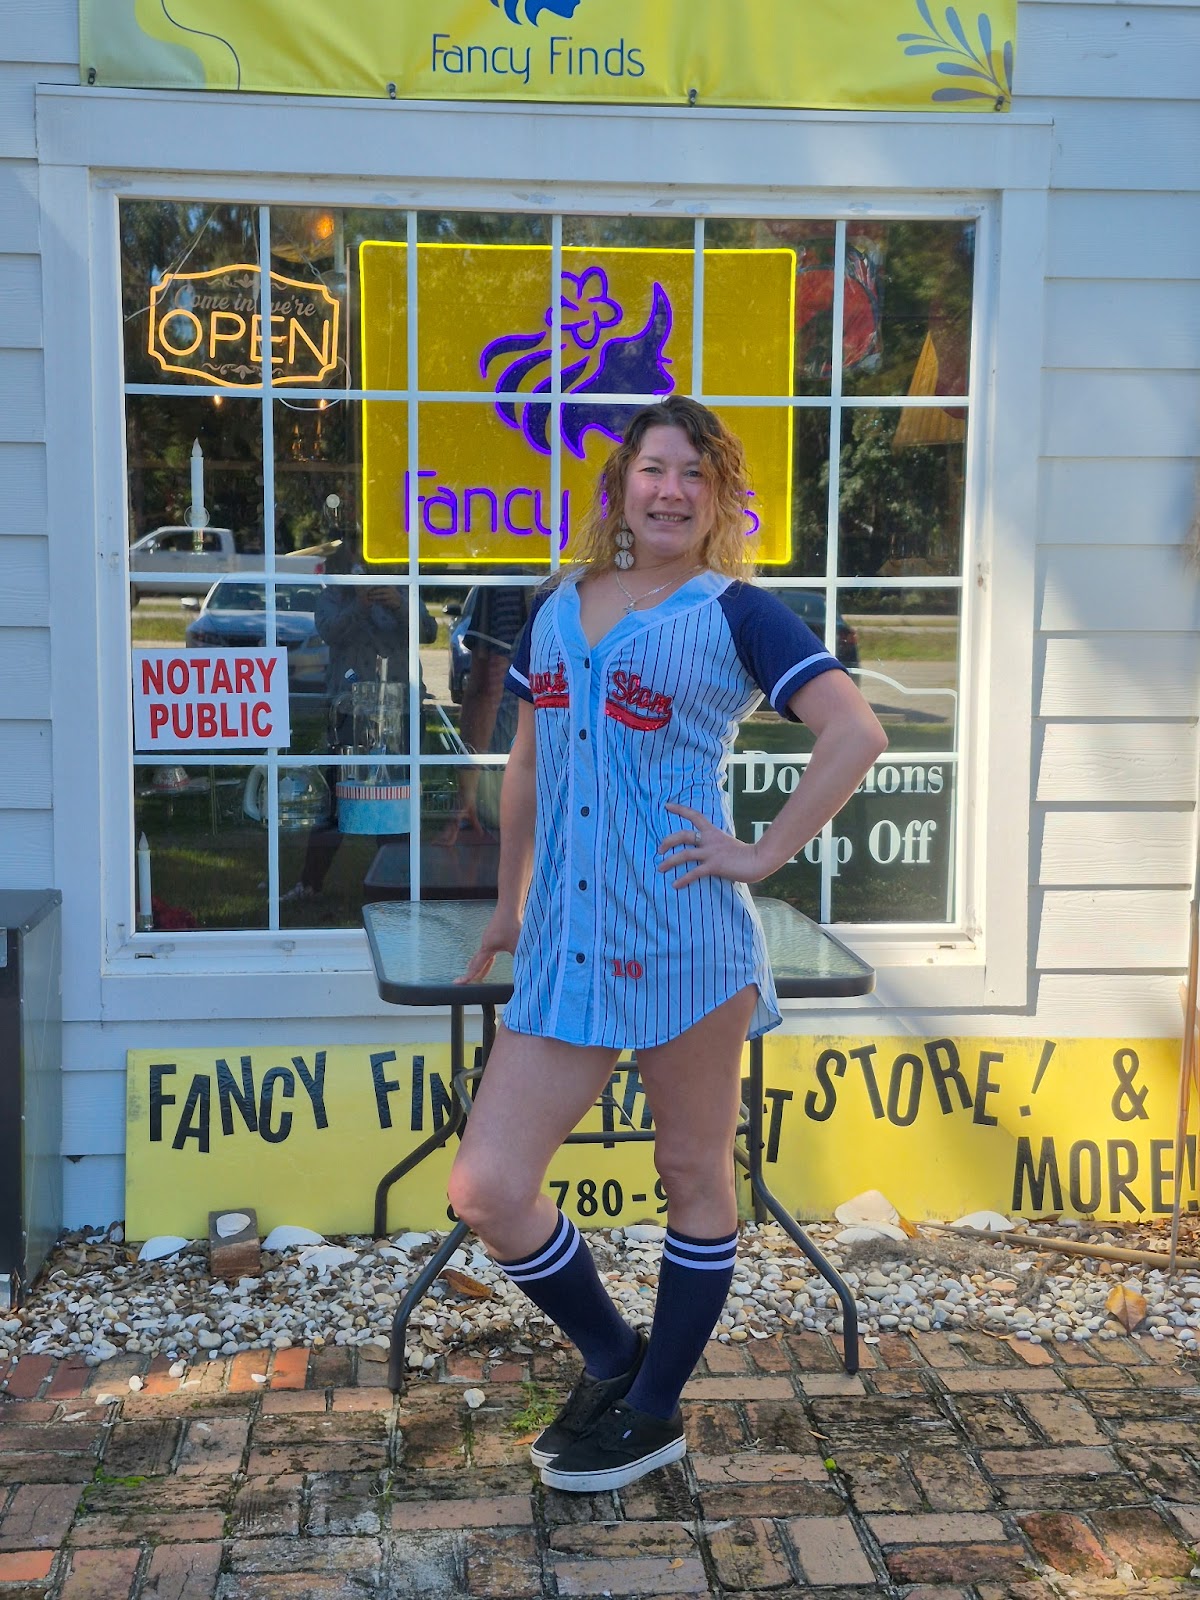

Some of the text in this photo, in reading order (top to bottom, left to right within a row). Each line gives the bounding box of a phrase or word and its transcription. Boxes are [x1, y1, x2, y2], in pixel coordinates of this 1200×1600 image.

[432, 33, 646, 85] Fancy Finds
[174, 284, 230, 312] Come
[158, 308, 330, 367] OPEN
[404, 470, 571, 551] Fancy
[141, 657, 278, 695] NOTARY
[611, 669, 674, 716] Slam
[149, 701, 274, 739] PUBLIC
[741, 750, 945, 795] Doions
[868, 819, 938, 865] Off
[610, 959, 644, 980] 10
[148, 1050, 329, 1153] FANCY
[369, 1047, 483, 1148] FIN
[1111, 1047, 1150, 1122] &
[1011, 1133, 1199, 1214] MORE!
